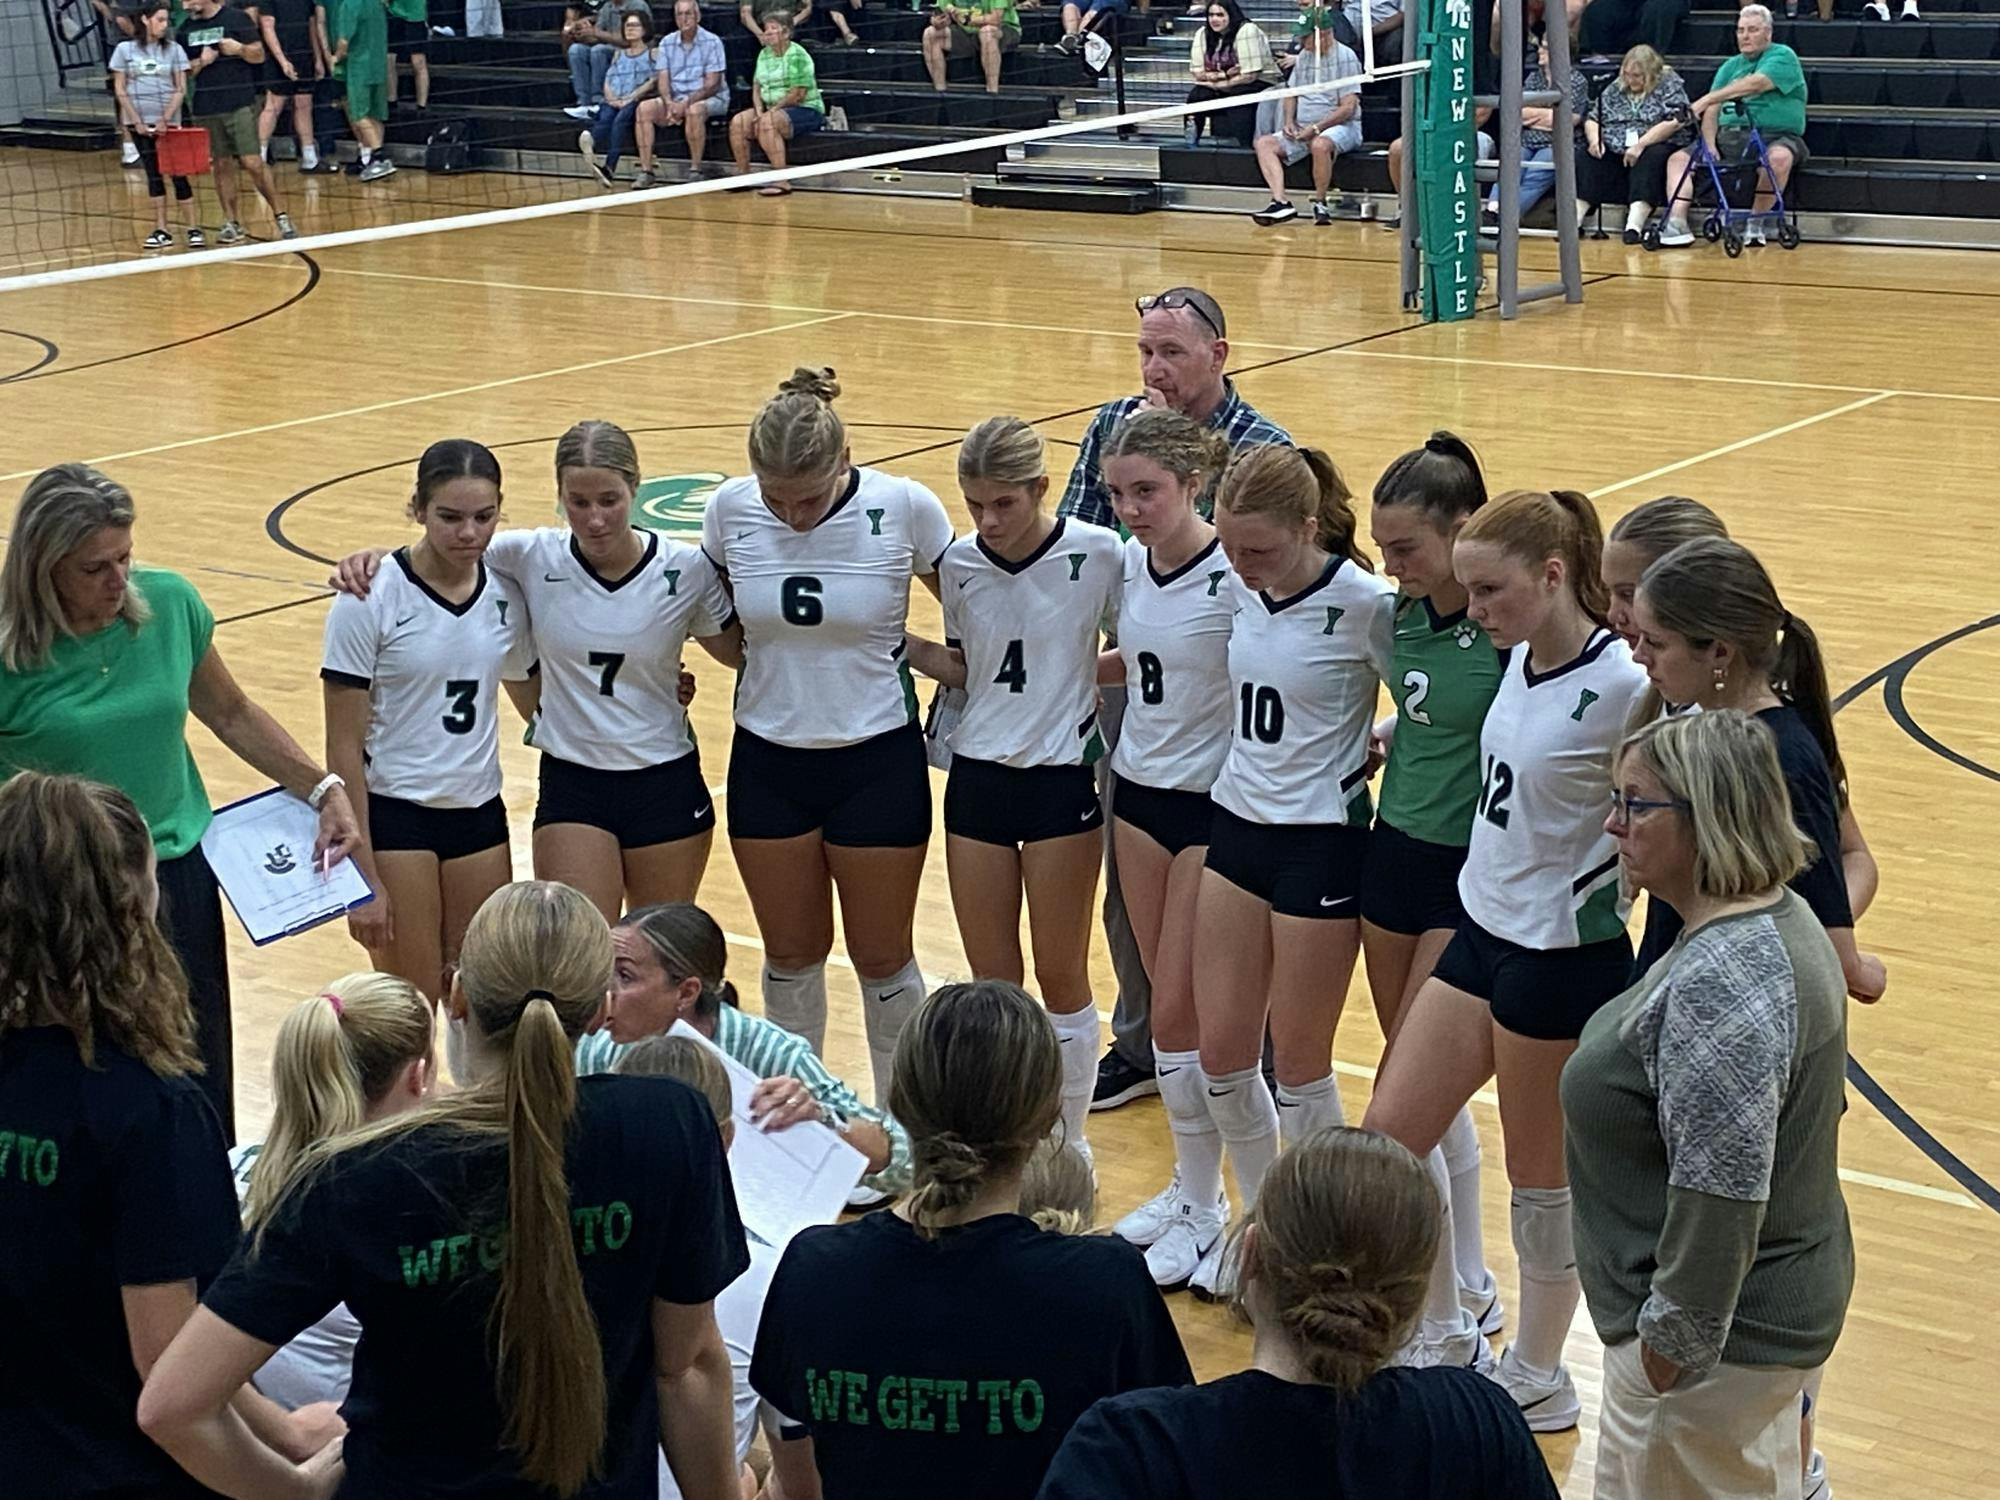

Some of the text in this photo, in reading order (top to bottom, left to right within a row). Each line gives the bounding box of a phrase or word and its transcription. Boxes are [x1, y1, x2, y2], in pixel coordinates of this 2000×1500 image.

[1451, 36, 1468, 123] NEW
[1453, 140, 1469, 314] CASTLE
[866, 508, 885, 536] Y
[663, 569, 681, 596] Y
[1068, 552, 1088, 582] Y
[1207, 570, 1226, 597] Y
[780, 575, 824, 627] 6
[1323, 606, 1345, 636] Y
[588, 650, 626, 697] 7
[992, 638, 1027, 693] 4
[1137, 650, 1164, 705] 8
[442, 679, 479, 735] 3
[1240, 681, 1285, 745] 10
[1402, 668, 1432, 727] 2
[1570, 687, 1600, 722] Y
[1479, 753, 1513, 831] 12
[18, 1134, 59, 1187] TO
[573, 1200, 633, 1256] TO
[806, 1367, 1045, 1435] WE GET TO
